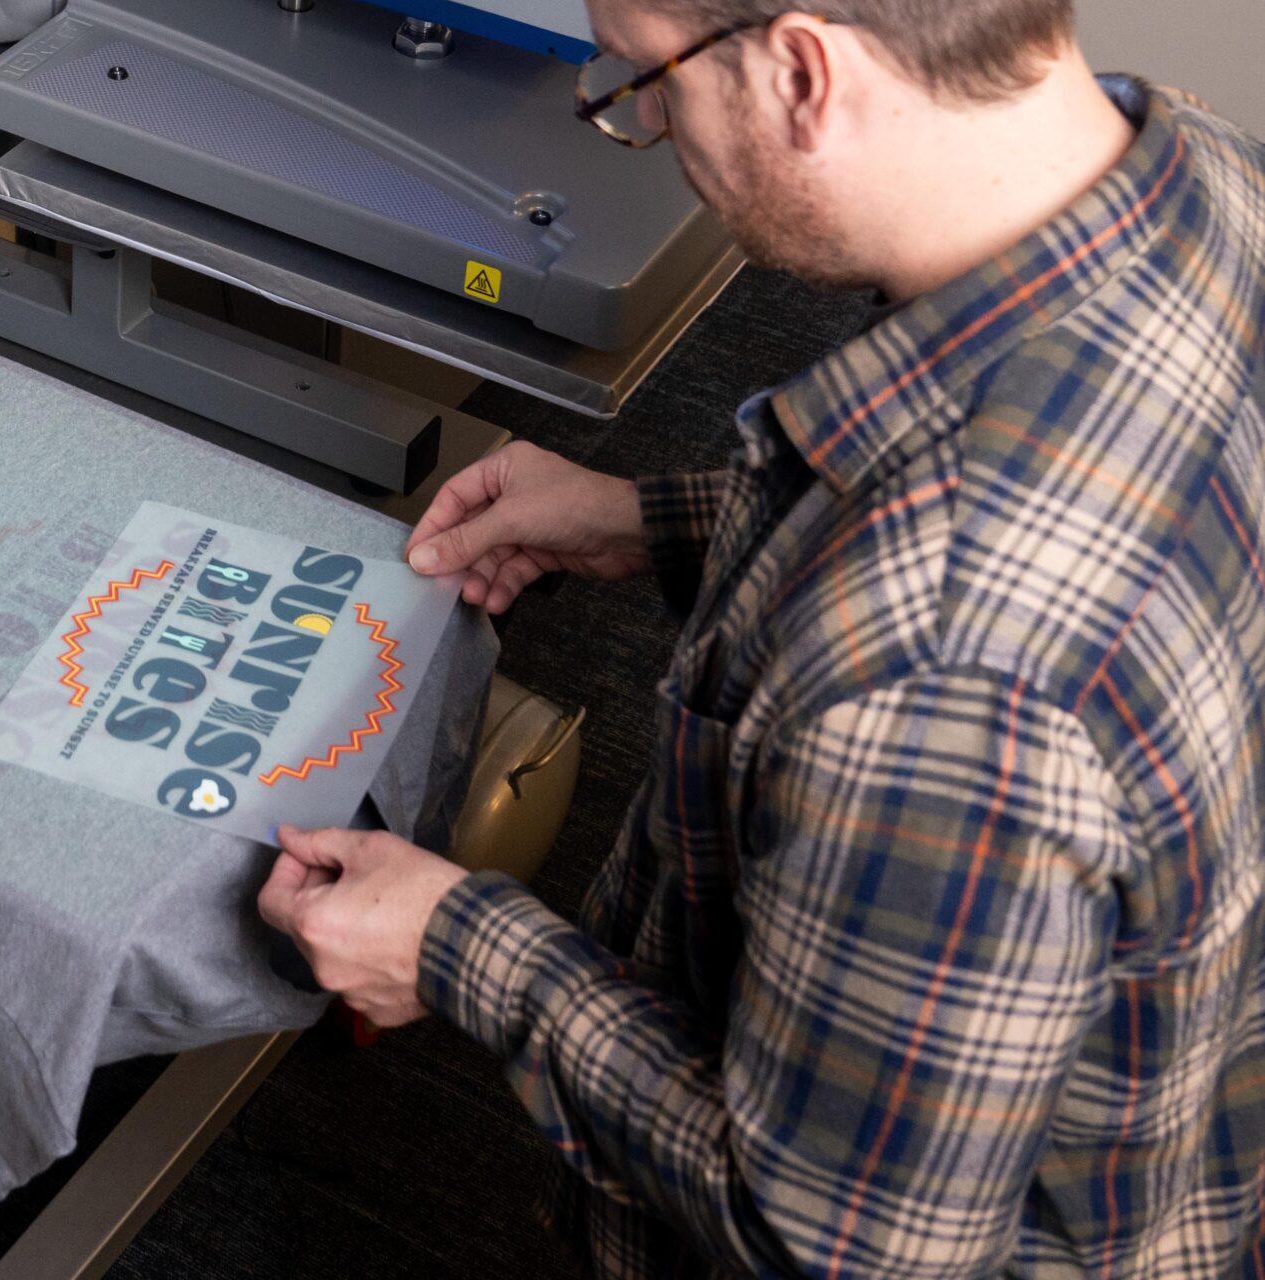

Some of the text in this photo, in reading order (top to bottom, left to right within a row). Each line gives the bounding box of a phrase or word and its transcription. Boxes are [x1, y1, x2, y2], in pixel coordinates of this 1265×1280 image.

[60, 528, 217, 760] BREAKFAST SERVED SUNRISE TO SUNSET
